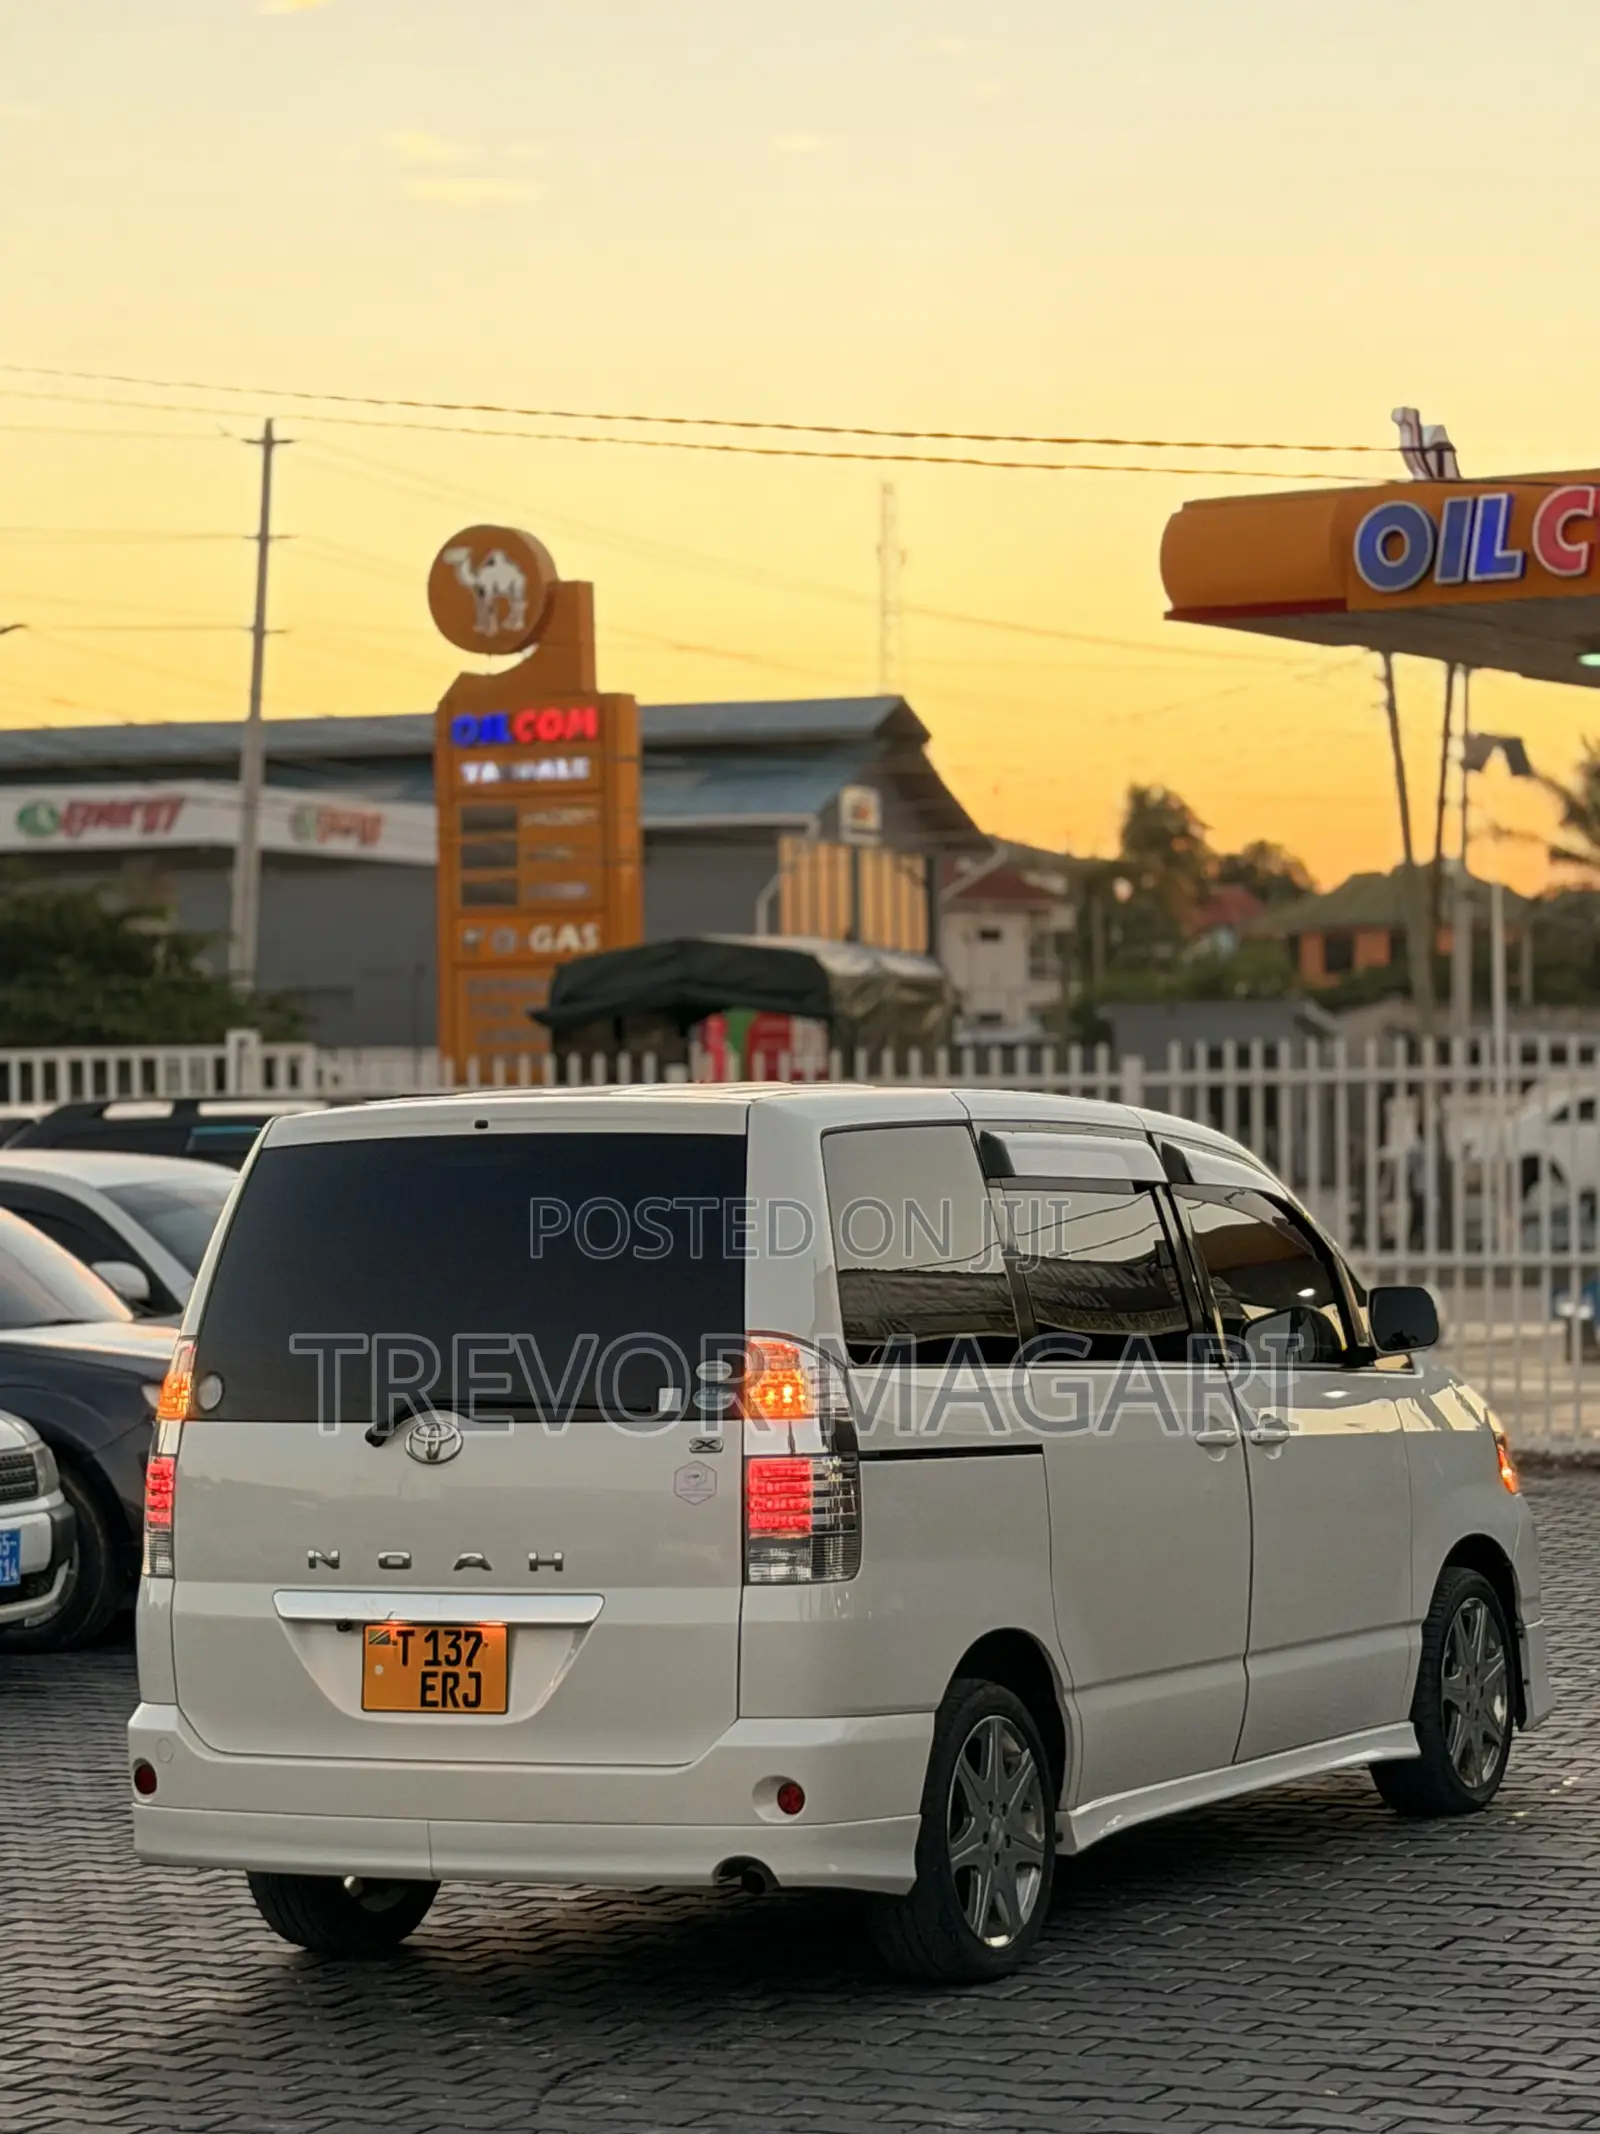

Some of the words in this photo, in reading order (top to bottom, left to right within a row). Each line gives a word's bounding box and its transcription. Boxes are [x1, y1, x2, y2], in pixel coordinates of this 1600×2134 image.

[307, 1550, 564, 1572] NOAH
[396, 1629, 415, 1667] T
[423, 1629, 484, 1668] 137
[420, 1671, 482, 1708] ERJ
